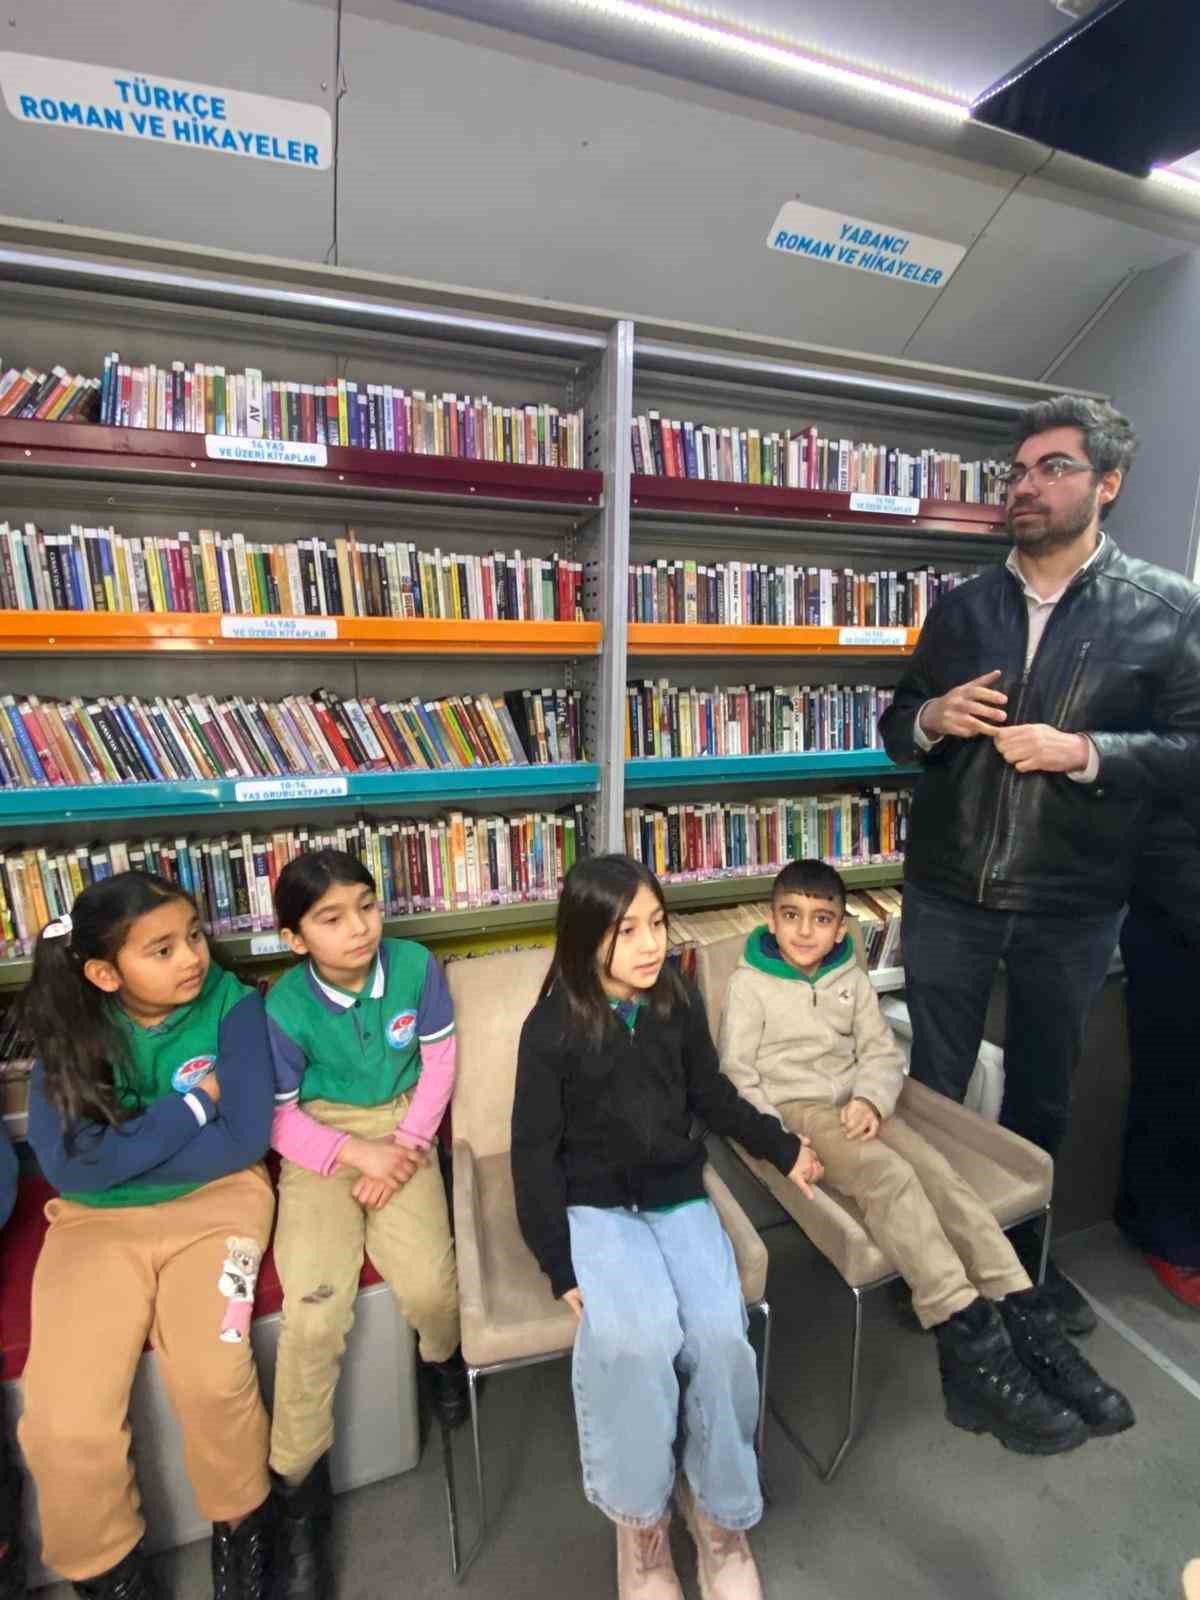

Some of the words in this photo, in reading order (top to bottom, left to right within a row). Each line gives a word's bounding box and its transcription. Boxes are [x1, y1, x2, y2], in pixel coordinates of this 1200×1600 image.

[113, 76, 227, 121] TÜRKÇE
[19, 95, 125, 132] ROMAN
[130, 112, 166, 139] VE
[172, 116, 320, 166] HİKAYELER
[774, 231, 836, 260] ROMAN
[837, 247, 857, 265] VE
[857, 251, 944, 286] HİKAYELER
[839, 223, 910, 256] YABANCI
[219, 448, 232, 457] VE
[234, 447, 265, 460] ÜZERİ
[266, 451, 317, 464] KİTAPLAR
